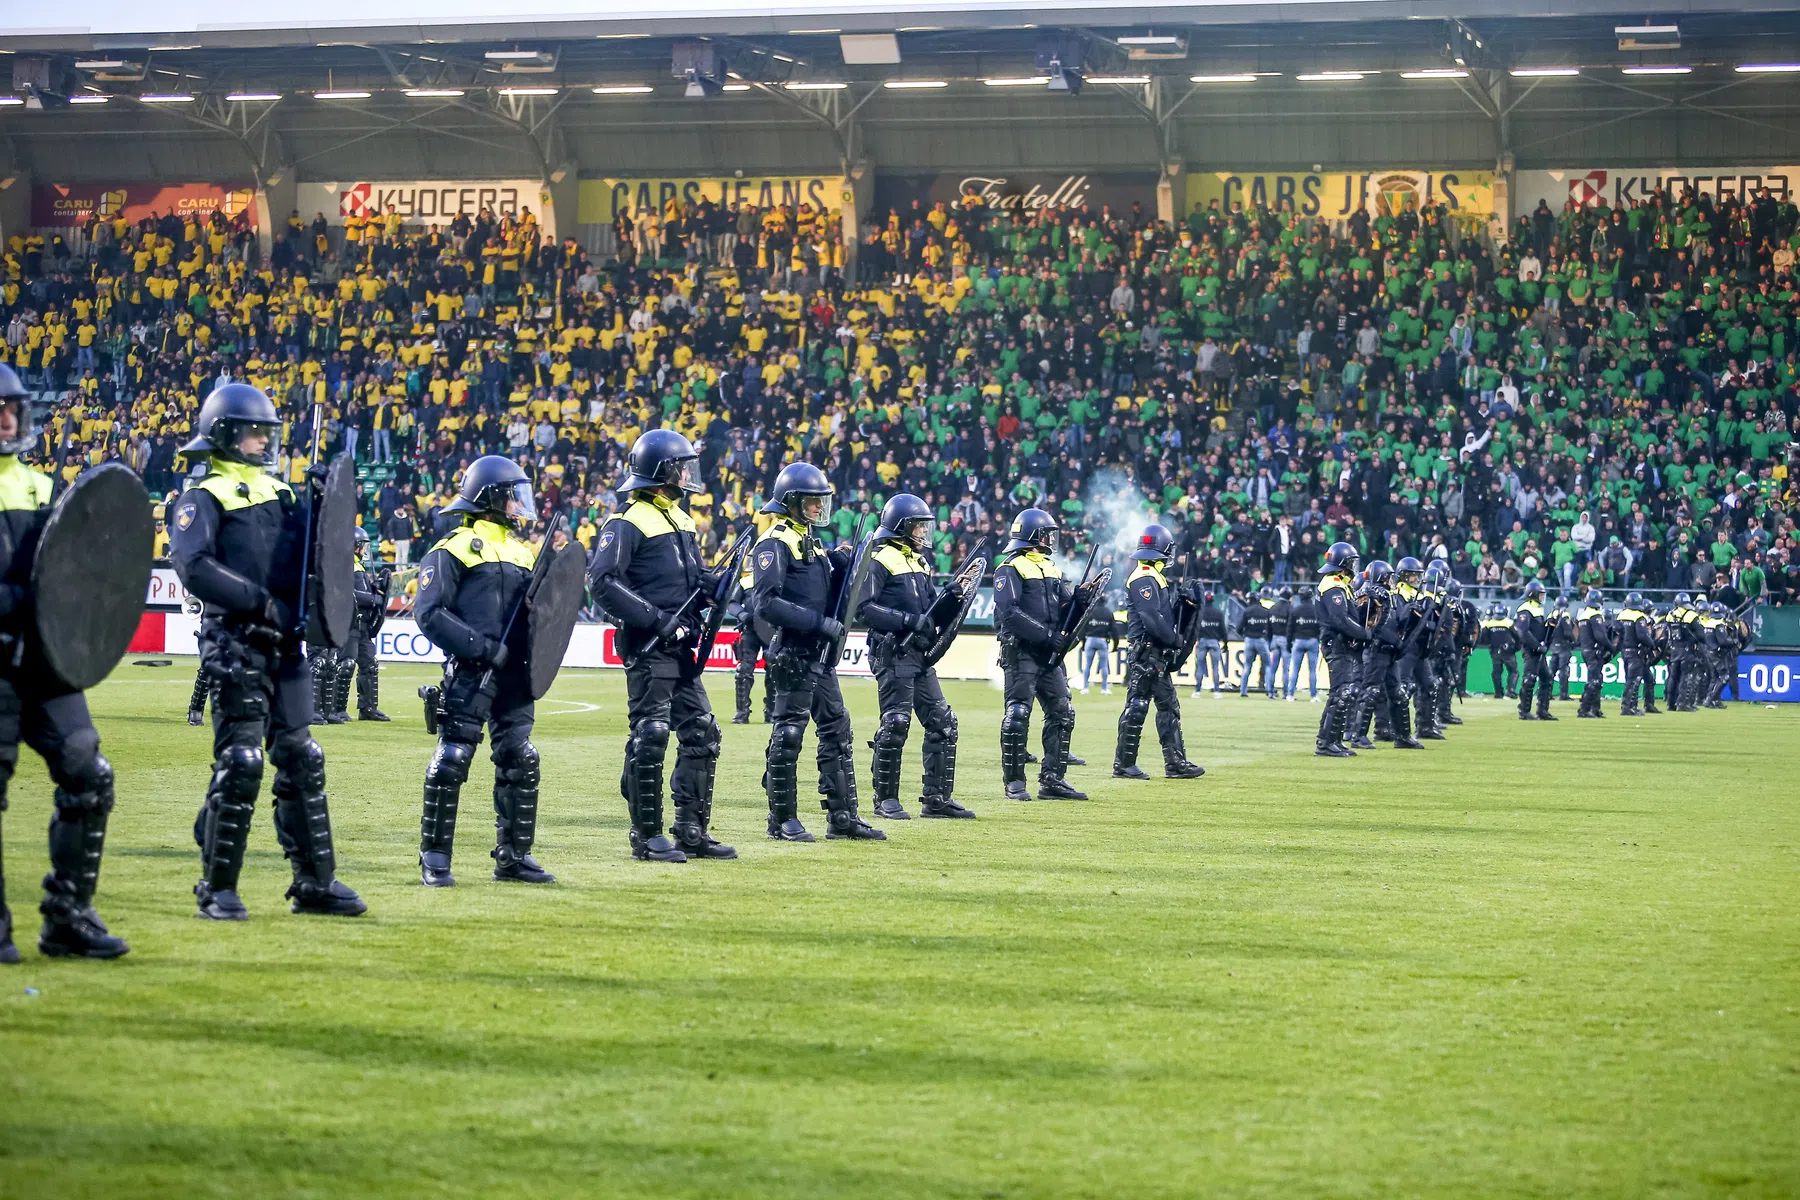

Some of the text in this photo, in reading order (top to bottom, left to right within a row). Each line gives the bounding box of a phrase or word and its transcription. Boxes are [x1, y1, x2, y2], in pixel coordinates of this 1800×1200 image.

[54, 199, 93, 209] CARU
[177, 198, 218, 208] CARU
[378, 188, 517, 217] KYOCERA
[951, 176, 1090, 209] Fratelli
[1222, 174, 1321, 216] CARS
